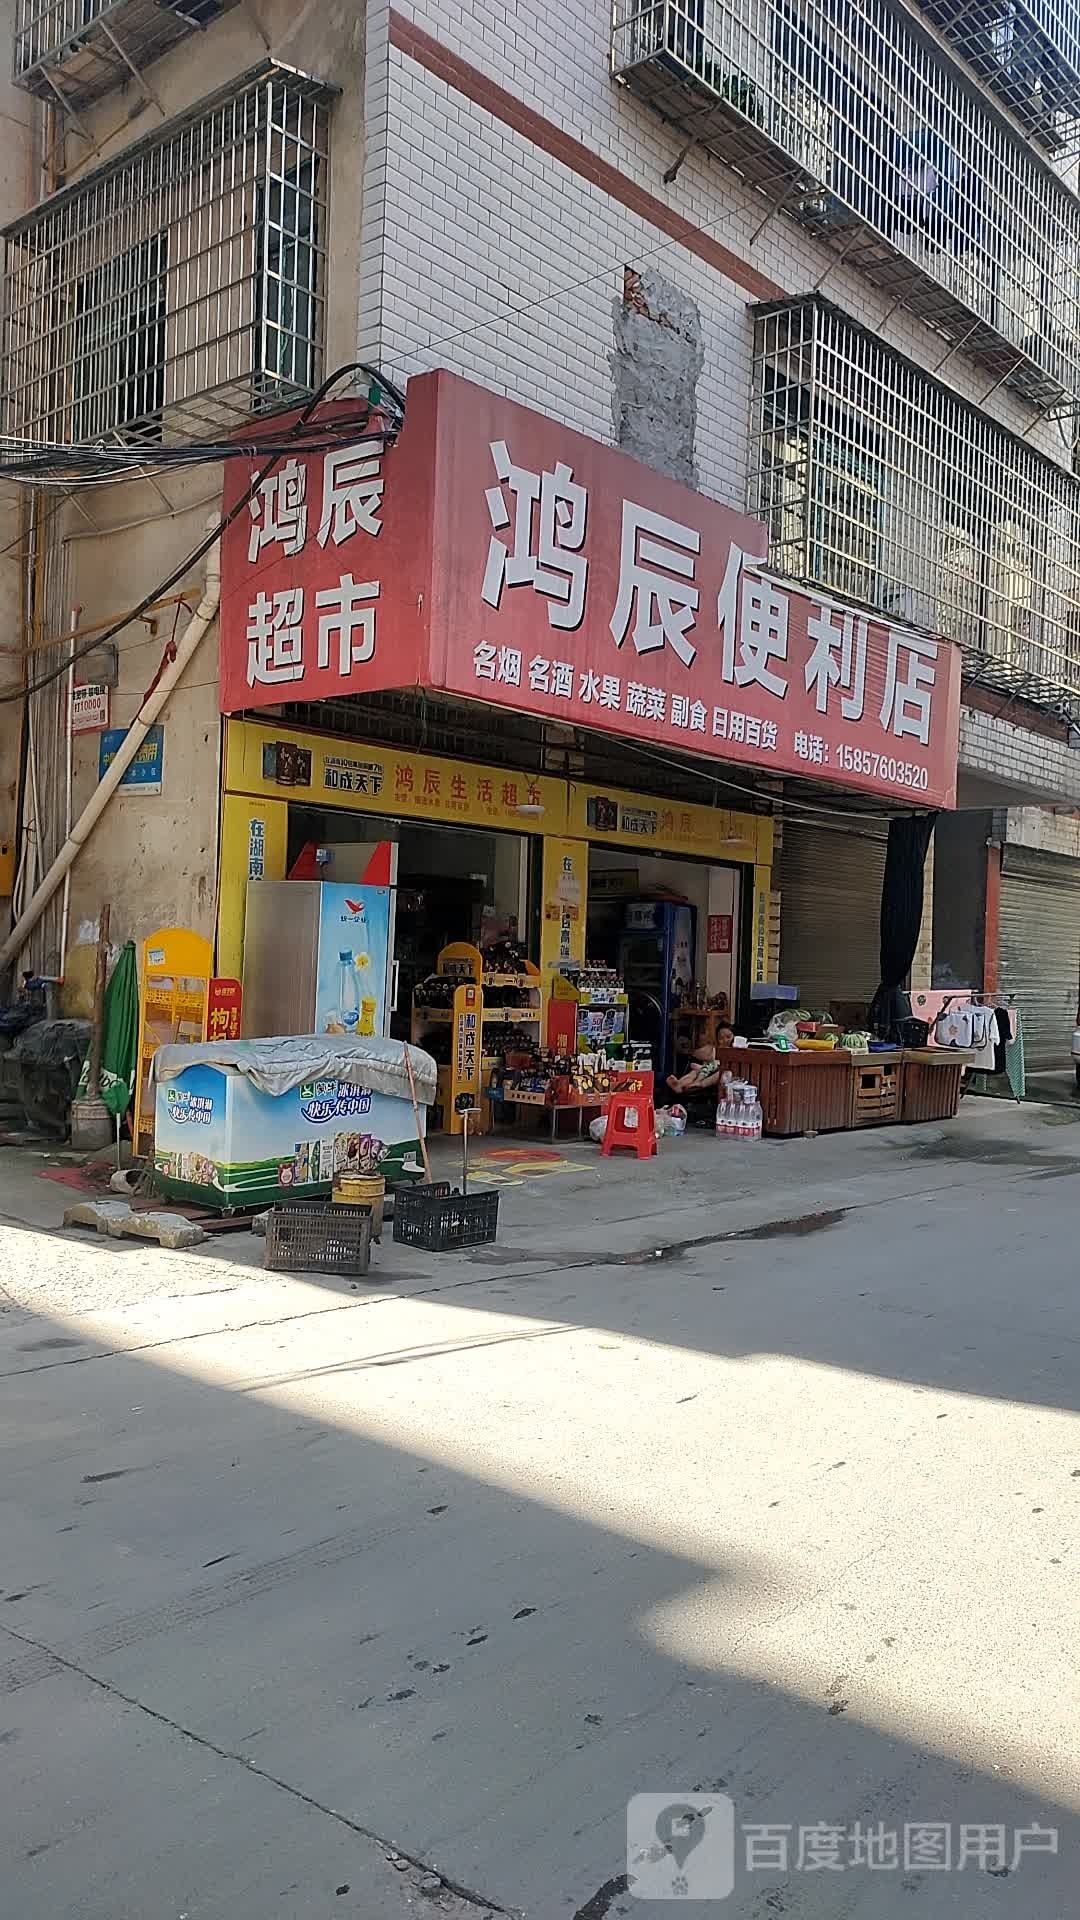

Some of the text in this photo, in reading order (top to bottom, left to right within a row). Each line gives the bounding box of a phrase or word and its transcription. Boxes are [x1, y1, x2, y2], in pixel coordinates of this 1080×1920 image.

[248, 440, 385, 564] 鸿辰
[247, 573, 381, 688] 超市
[480, 440, 939, 746] 鸿辰便利店
[473, 640, 521, 687] 名烟
[527, 655, 574, 699] 名酒
[578, 669, 621, 710] 水果
[625, 681, 666, 722] 蔬菜
[670, 693, 708, 733] 副食
[712, 706, 778, 751] 日用百货
[836, 743, 928, 791] 15857603520
[325, 770, 383, 796] 和成天下
[249, 819, 264, 881] 在湖南
[465, 1012, 477, 1081] 和成天下
[304, 1097, 371, 1121] 快乐传中国
